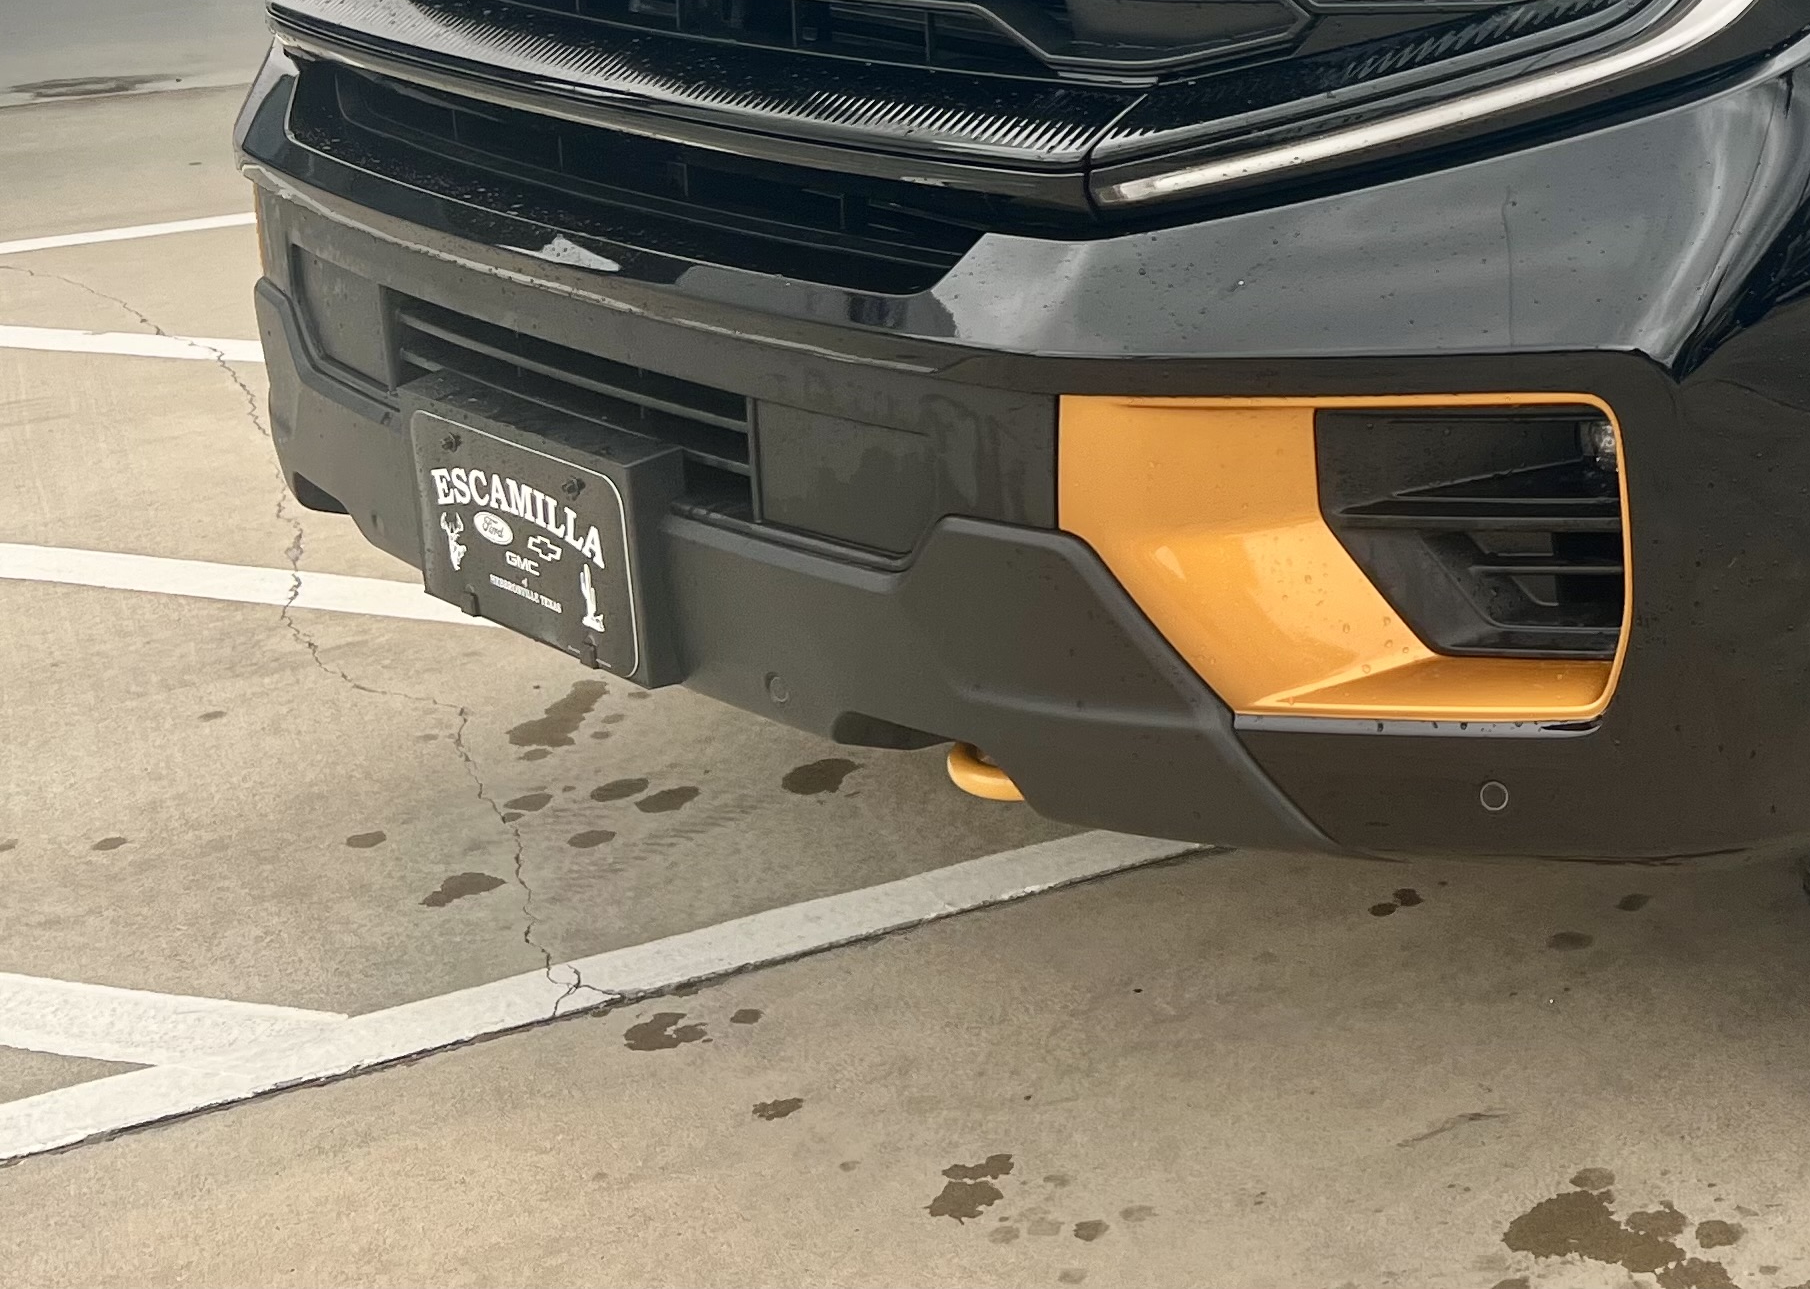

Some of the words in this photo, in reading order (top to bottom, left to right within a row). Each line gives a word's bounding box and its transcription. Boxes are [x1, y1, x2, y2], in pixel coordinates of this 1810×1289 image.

[430, 467, 605, 570] ESCAMILLA
[505, 550, 540, 576] GMC
[540, 595, 562, 614] TEXAS
